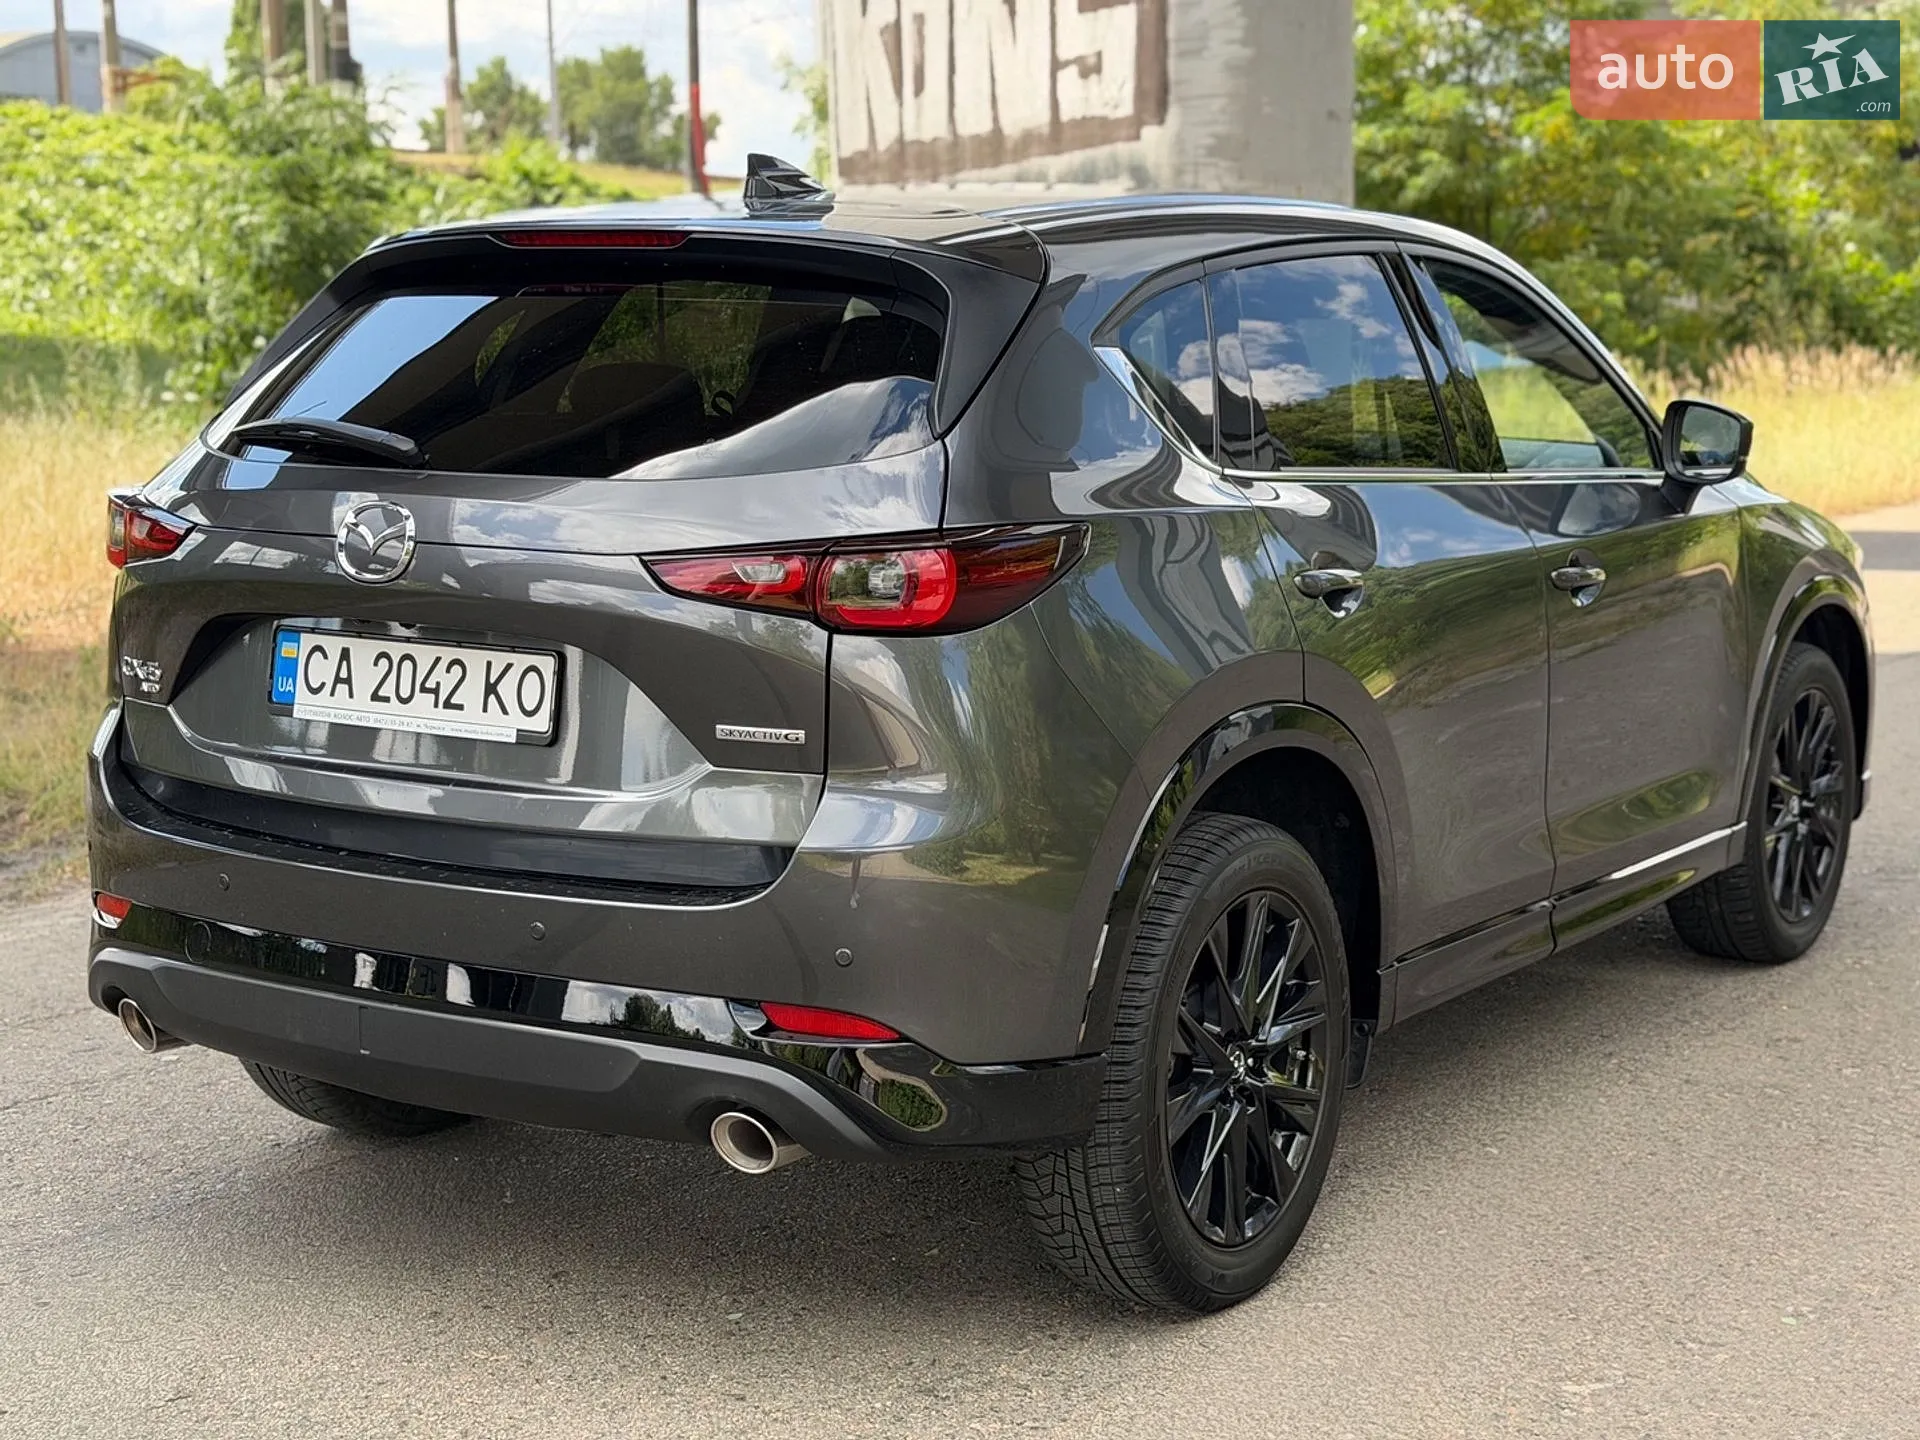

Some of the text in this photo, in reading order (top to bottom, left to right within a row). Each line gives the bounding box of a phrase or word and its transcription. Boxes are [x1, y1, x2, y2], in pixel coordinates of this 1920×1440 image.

[278, 676, 295, 694] UA
[303, 644, 546, 718] CA 2042 KO
